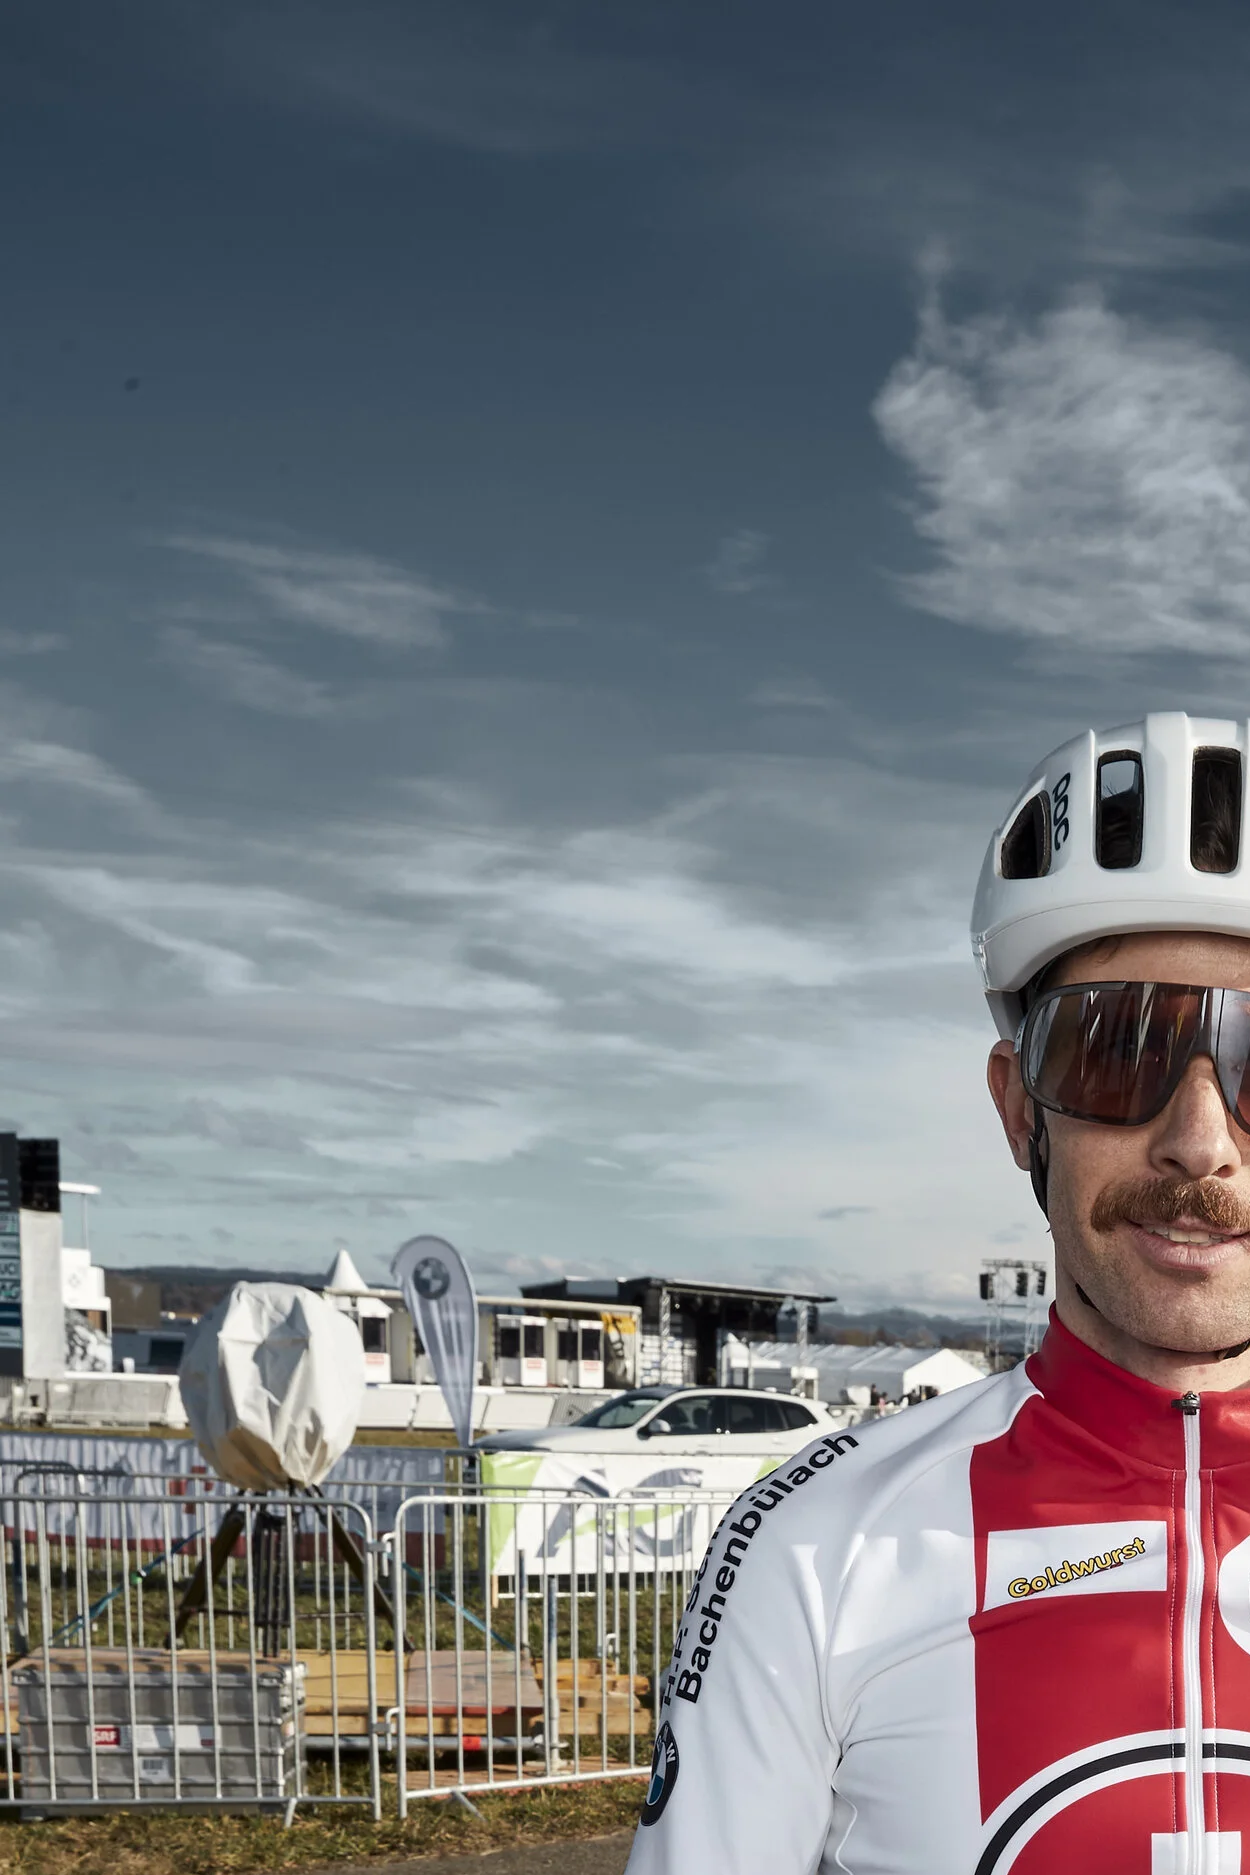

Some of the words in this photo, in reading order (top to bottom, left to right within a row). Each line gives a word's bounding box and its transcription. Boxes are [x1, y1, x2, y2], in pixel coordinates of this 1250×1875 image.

[1052, 772, 1070, 851] POC
[675, 1431, 860, 1704] Bachenbülach
[1008, 1537, 1146, 1598] Goldwurst
